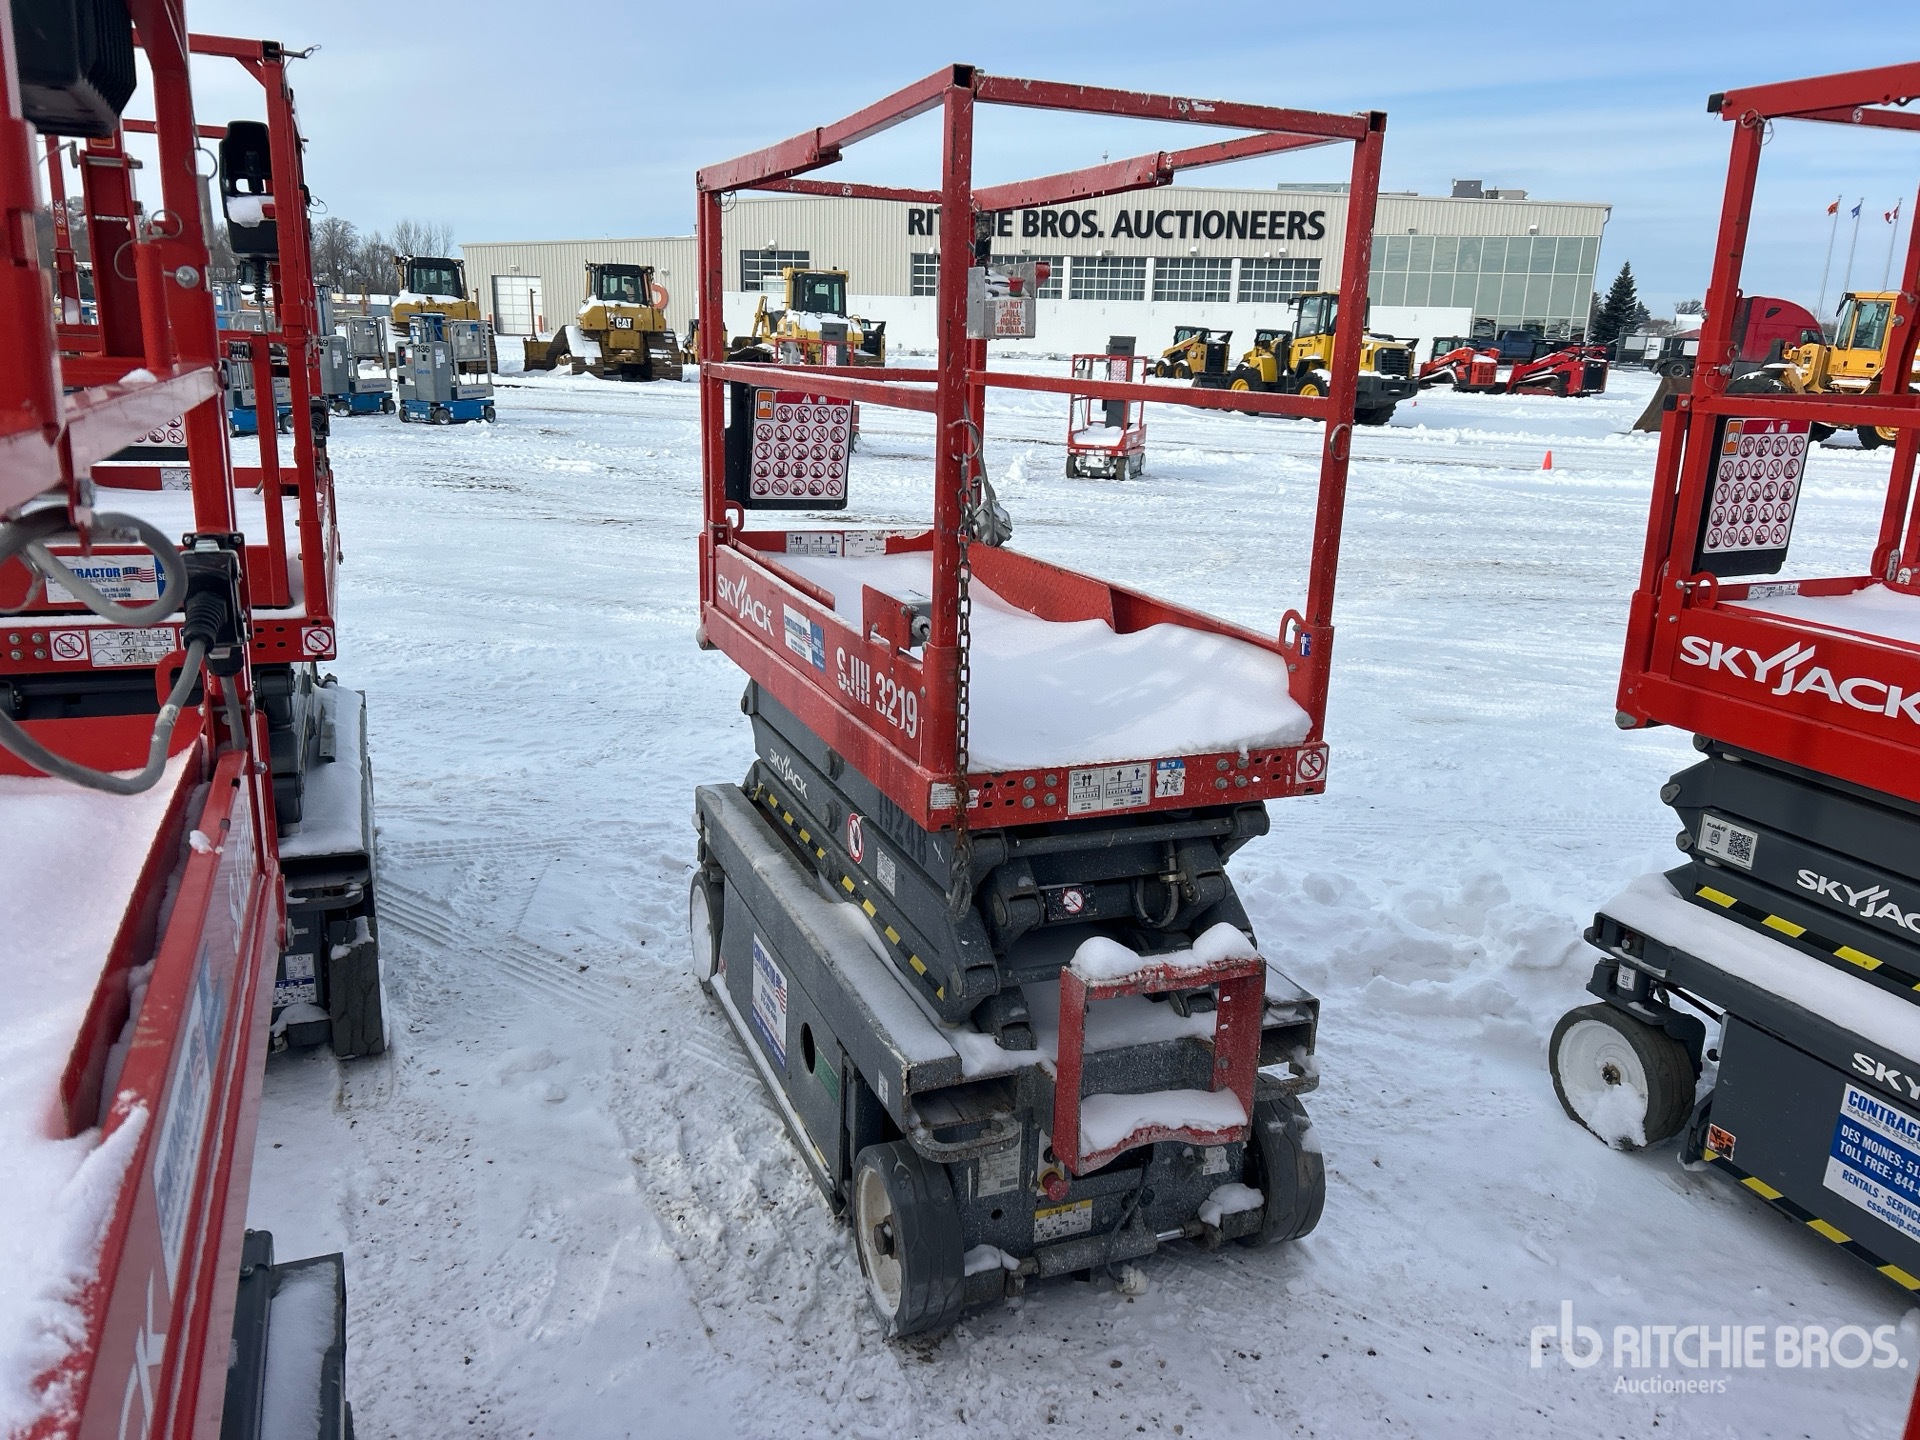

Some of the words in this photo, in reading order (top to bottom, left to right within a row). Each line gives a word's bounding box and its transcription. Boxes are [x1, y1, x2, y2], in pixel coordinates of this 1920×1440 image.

[1022, 209, 1104, 238] BROS.
[1111, 210, 1326, 240] AUCTIONEERS
[616, 318, 632, 329] CAT
[717, 573, 774, 637] SKYJACK
[1679, 635, 1920, 725] SKYJACK
[875, 671, 918, 739] 3219
[769, 748, 808, 800] SKYJACK
[1847, 1105, 1881, 1129] SALES
[1848, 1090, 1920, 1142] CONTRAC
[1840, 1140, 1862, 1164] TOLL
[1864, 1155, 1893, 1180] FREE:
[1841, 1124, 1860, 1144] DES
[1861, 1138, 1904, 1169] MOINES:
[1842, 1169, 1879, 1198] RENTALS
